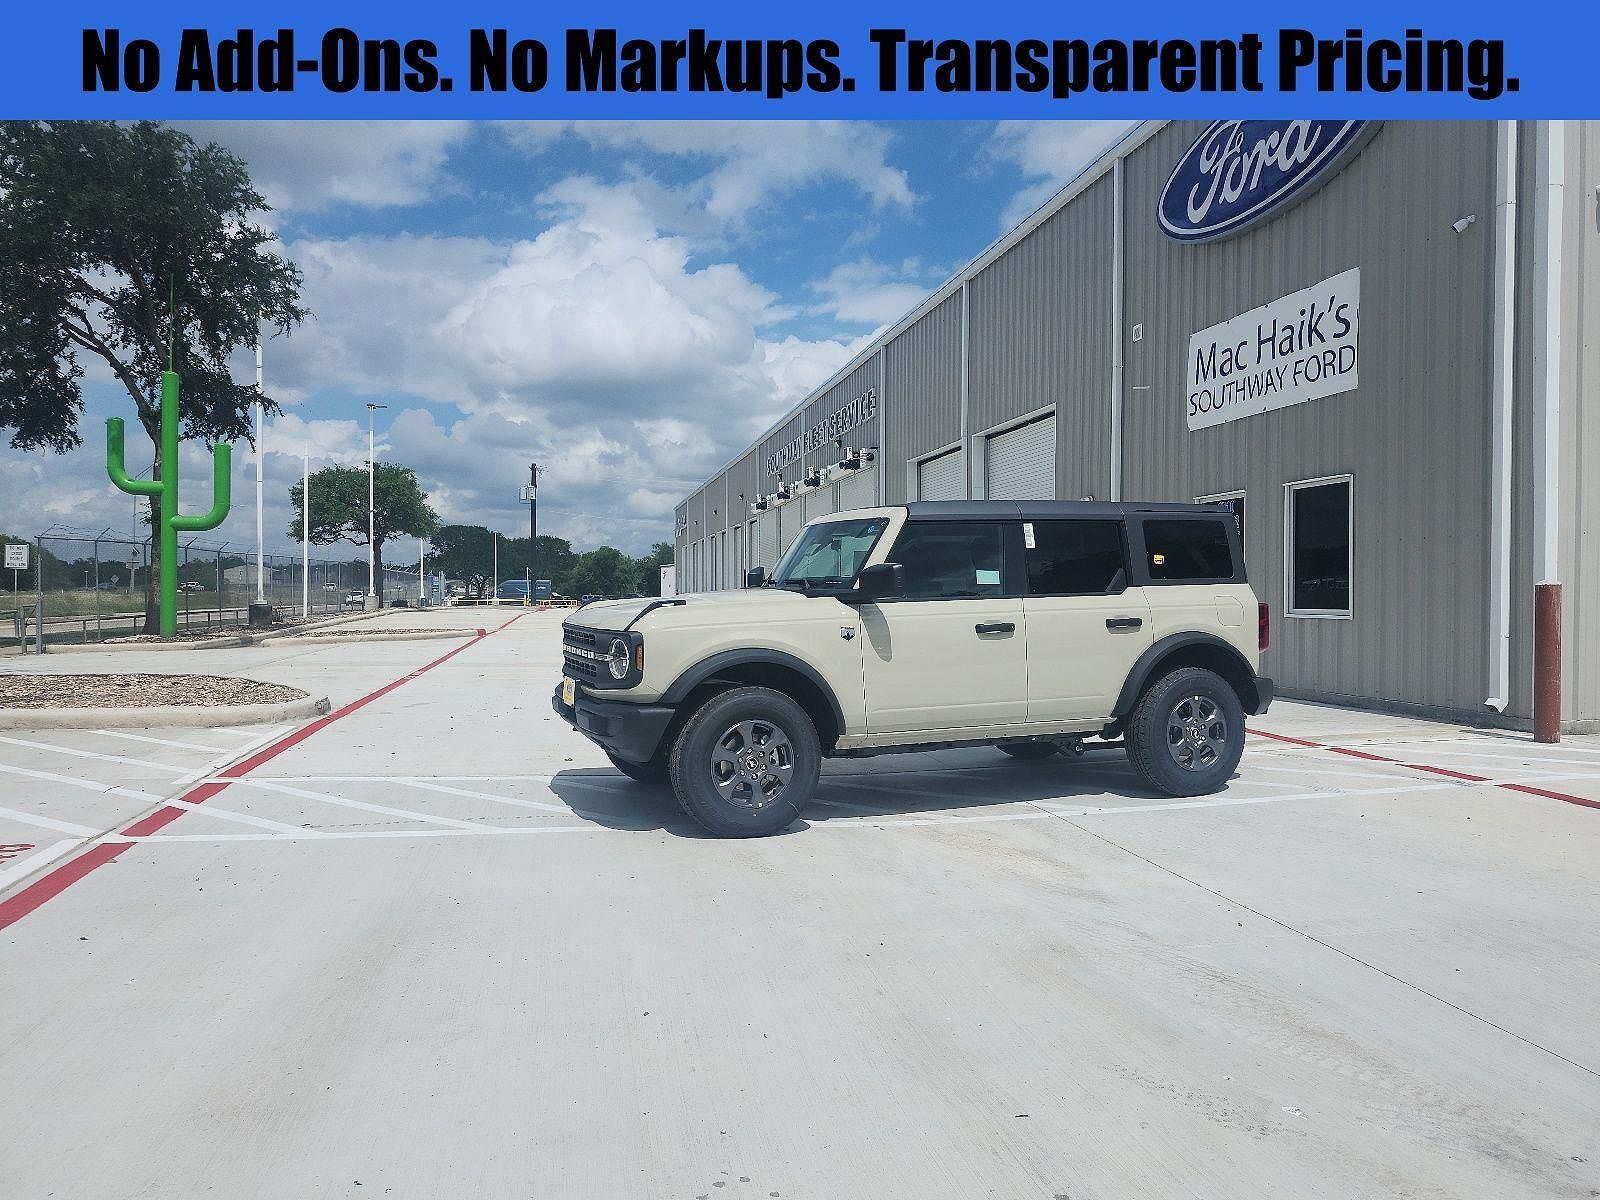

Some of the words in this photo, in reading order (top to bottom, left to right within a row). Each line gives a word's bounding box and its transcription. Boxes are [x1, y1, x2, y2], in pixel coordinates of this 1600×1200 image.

[1187, 119, 1322, 223] Ford
[1189, 363, 1289, 417] SOUTHWAY
[1292, 344, 1356, 387] FORD
[1195, 340, 1248, 386] Mac
[1256, 294, 1351, 365] Haik's
[803, 418, 830, 456] FLEET
[829, 388, 877, 441] SERVICE
